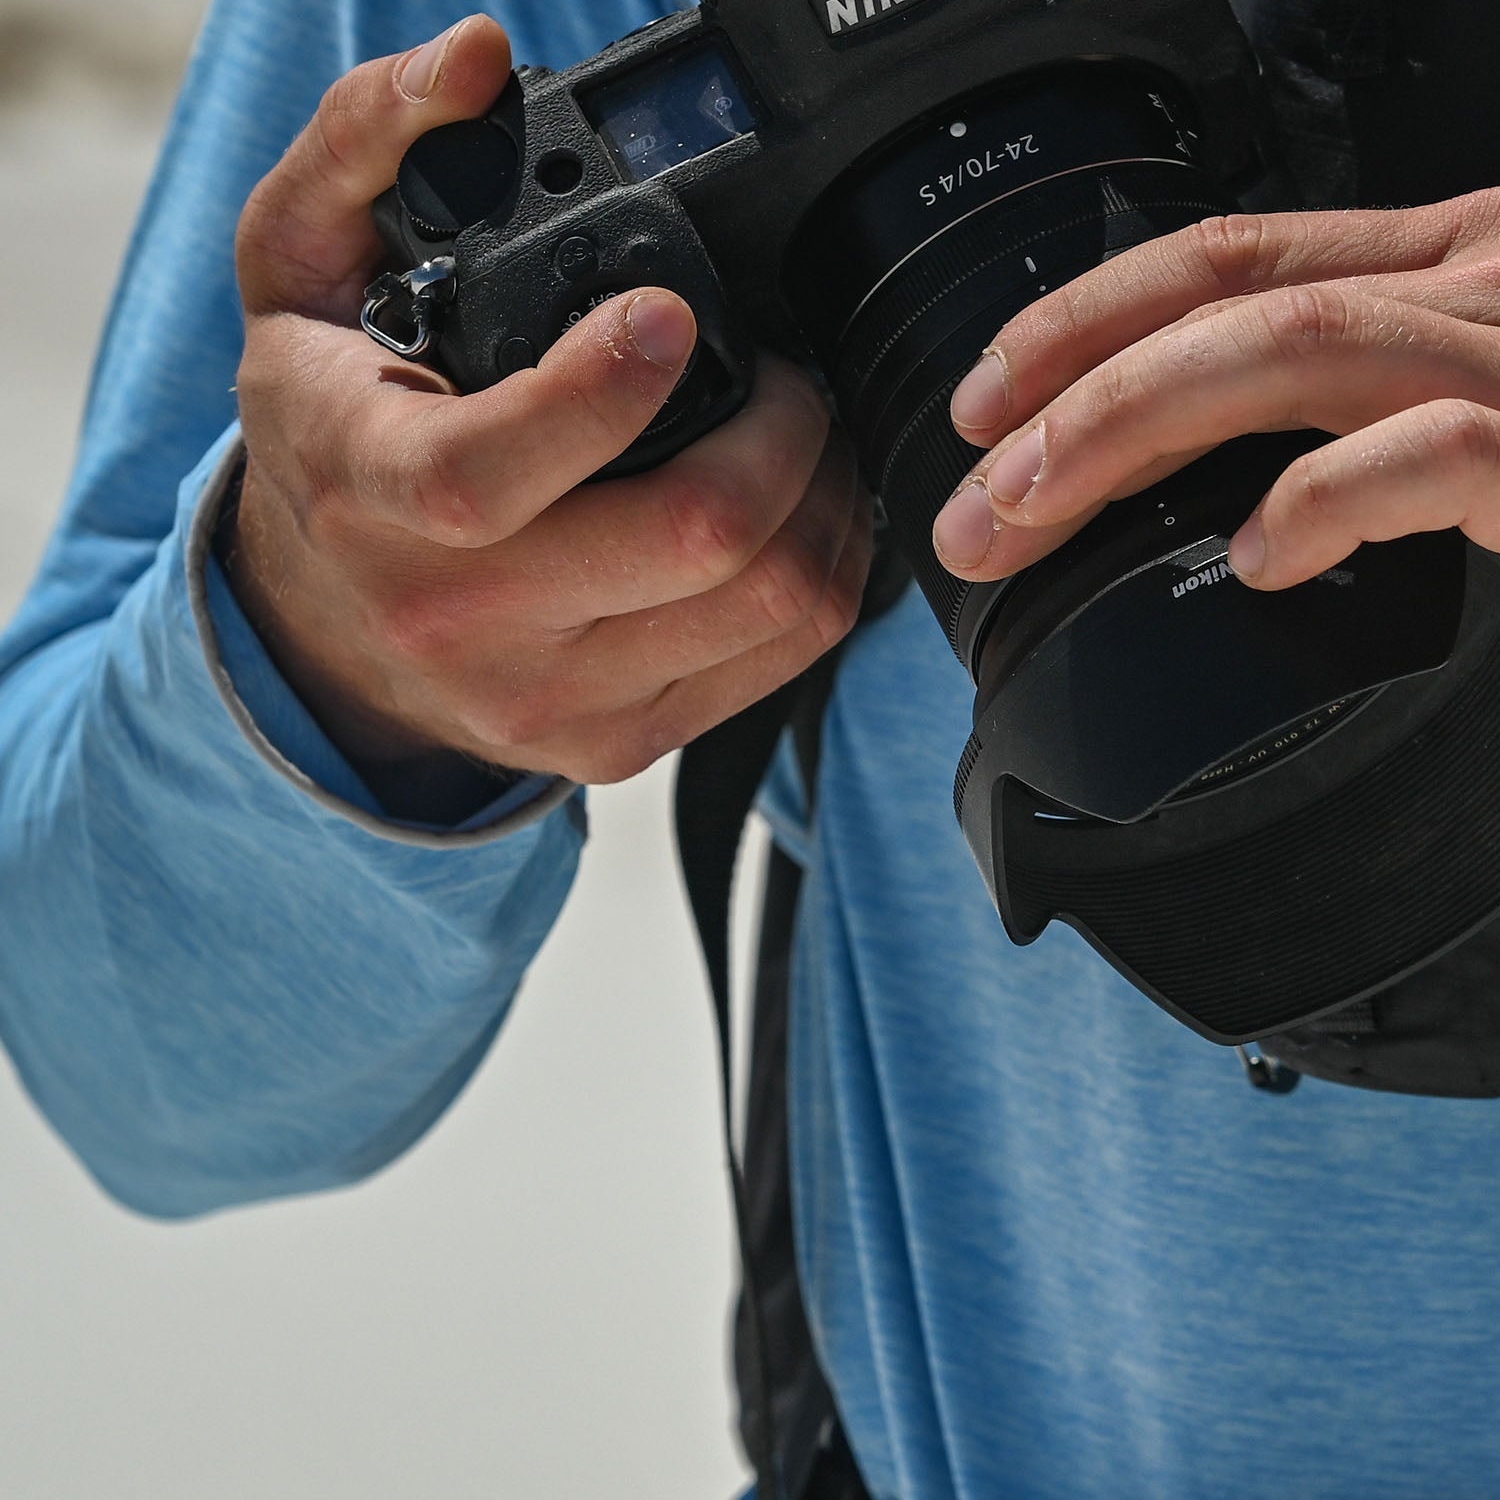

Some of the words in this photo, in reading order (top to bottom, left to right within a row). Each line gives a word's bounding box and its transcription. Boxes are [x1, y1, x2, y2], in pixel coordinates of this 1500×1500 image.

[938, 133, 1040, 194] 24-70/4
[918, 183, 937, 207] S
[1274, 732, 1300, 749] 010
